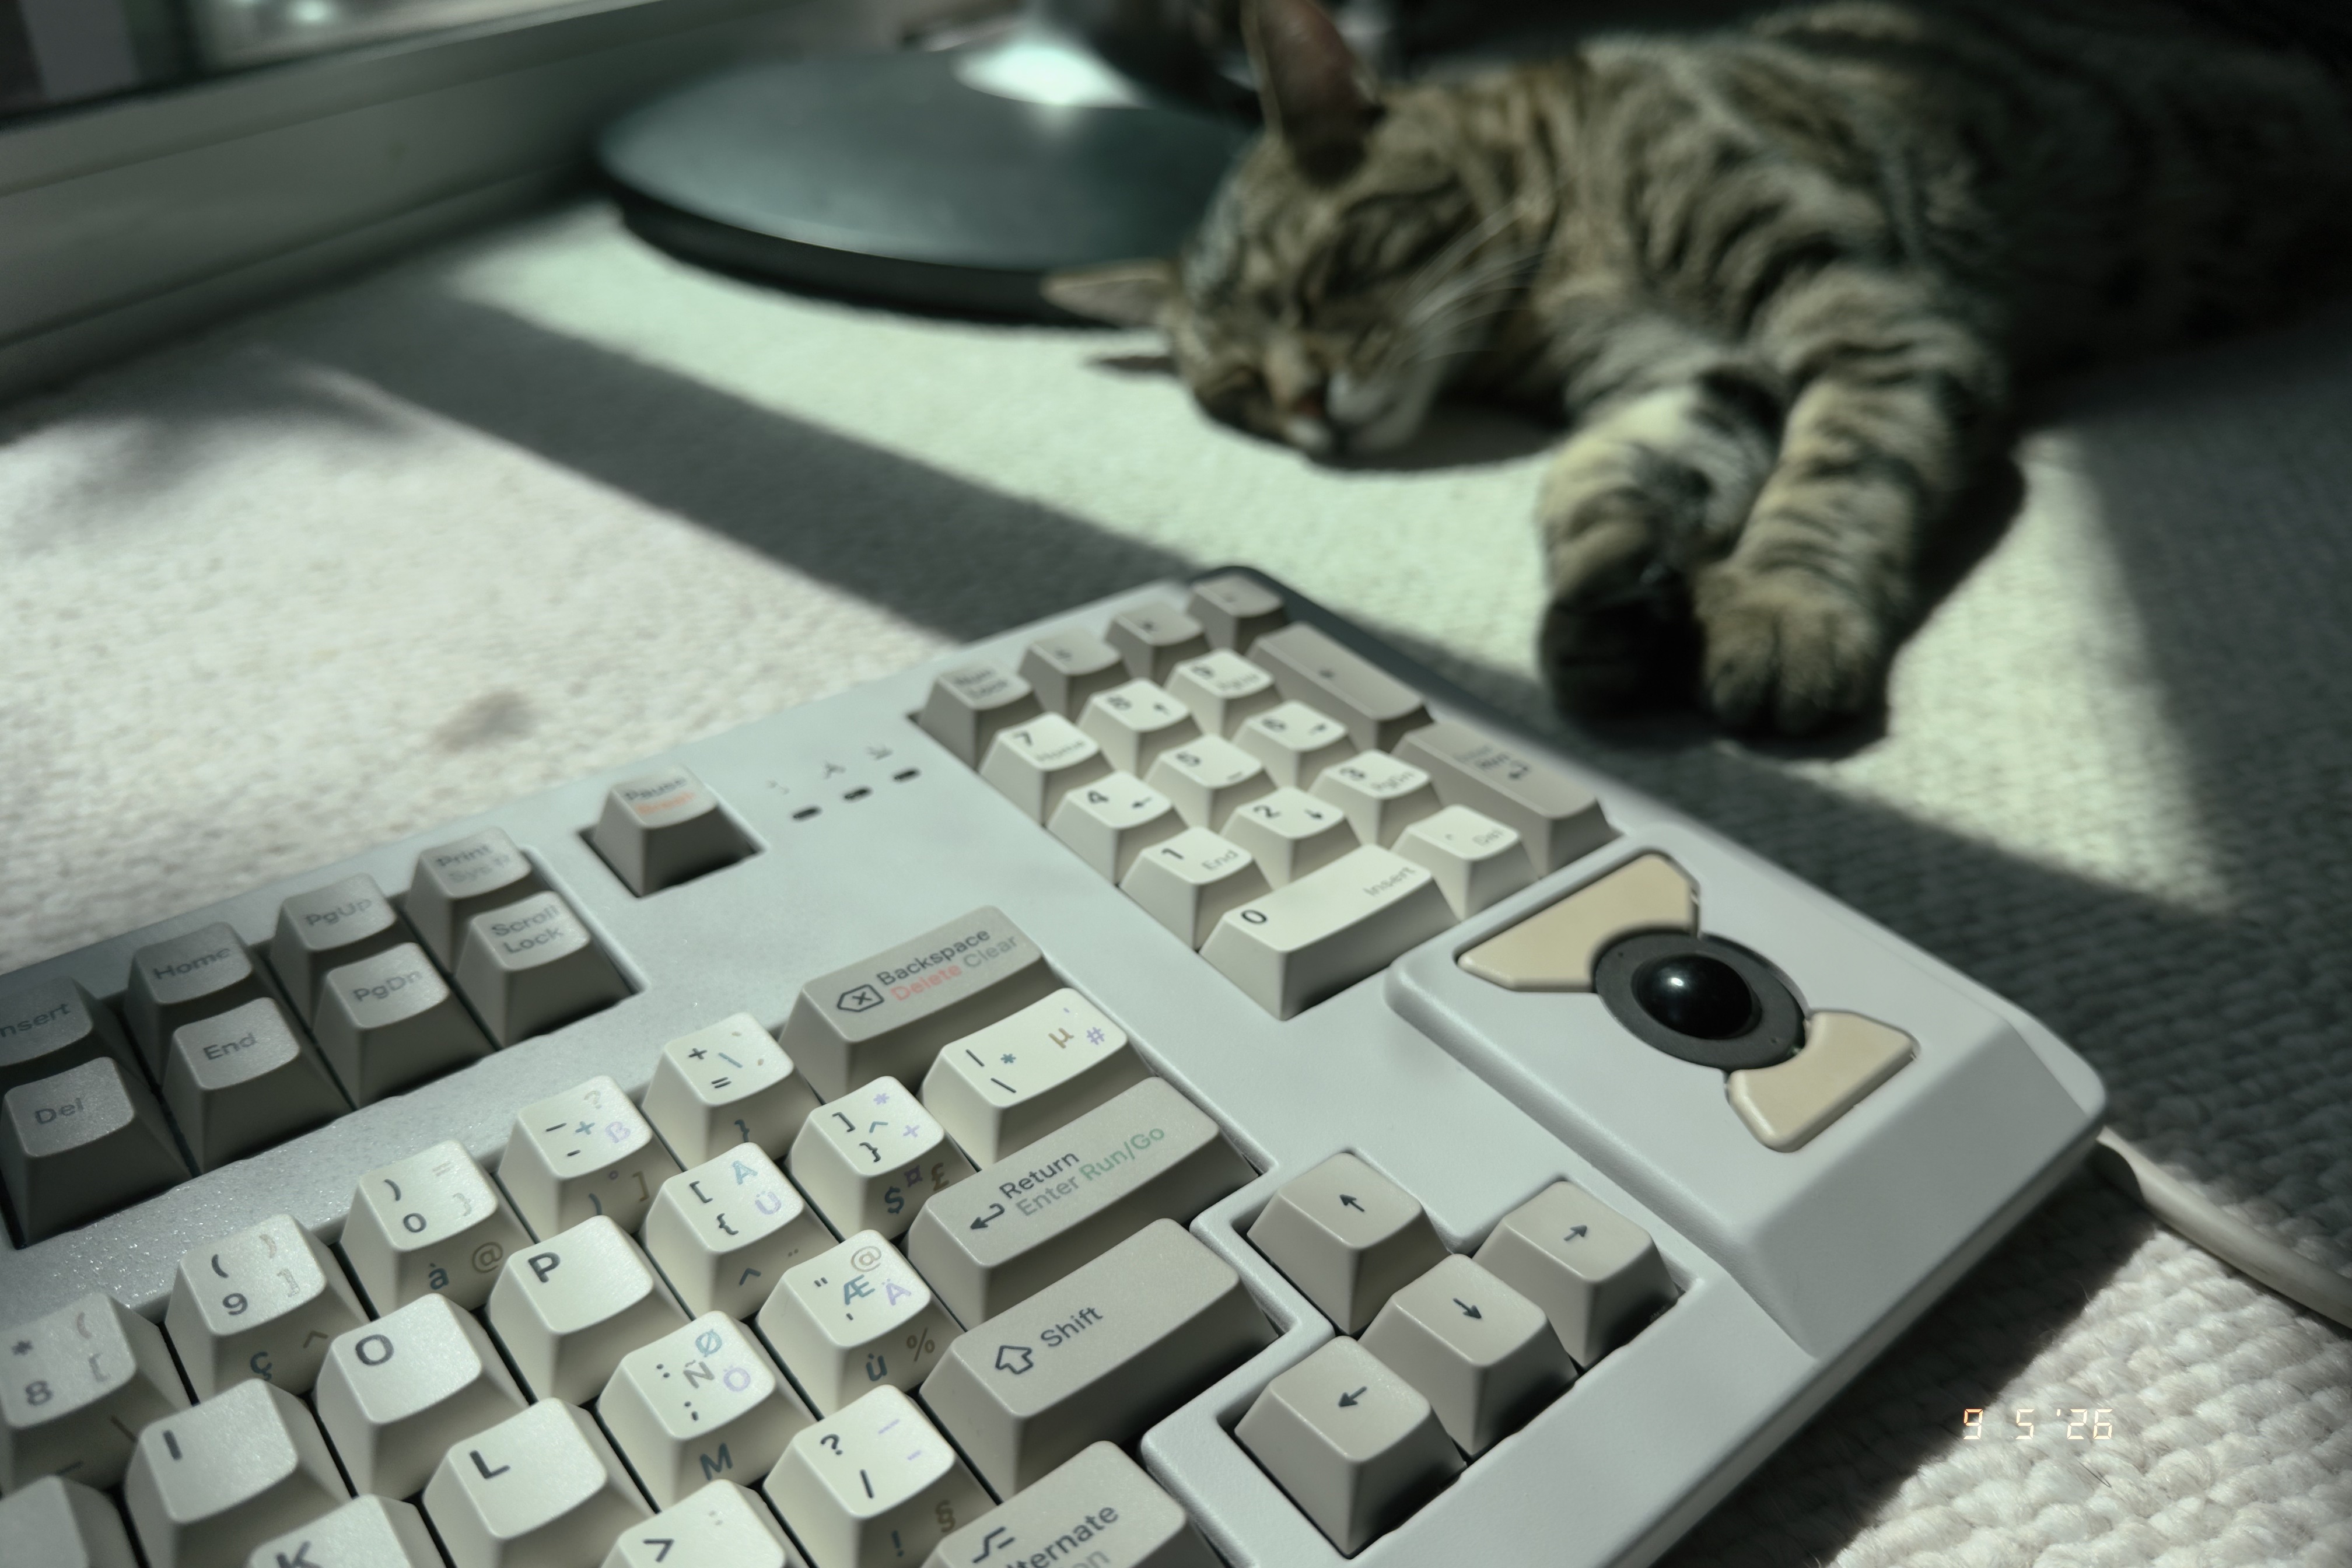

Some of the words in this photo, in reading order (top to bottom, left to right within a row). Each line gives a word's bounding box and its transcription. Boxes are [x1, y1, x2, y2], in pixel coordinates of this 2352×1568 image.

[1087, 790, 1110, 804] 4
[1252, 804, 1282, 820] 2
[1161, 848, 1184, 860] 1
[1201, 849, 1240, 872] End
[1363, 865, 1418, 897] Insert
[304, 898, 373, 926] PgUp
[491, 904, 562, 937] Scroll
[1240, 909, 1268, 926] 0
[502, 926, 565, 954] Lock
[153, 947, 231, 980] Home
[877, 930, 991, 986] Backspace
[890, 964, 963, 1002] Delete
[963, 936, 1018, 968] Clear
[353, 970, 424, 1002] PgDn
[202, 1032, 258, 1061] End
[35, 1097, 85, 1125] Del
[999, 1153, 1080, 1199] Return
[1016, 1176, 1080, 1217] Enter
[1079, 1128, 1165, 1181] Run/Go
[428, 1262, 450, 1290] à
[471, 1241, 505, 1273] @
[528, 1251, 561, 1283] P
[850, 1245, 883, 1272] @
[222, 1292, 249, 1316] 9
[844, 1274, 876, 1306] Æ
[881, 1278, 912, 1306] Ä
[1040, 1306, 1104, 1349] Shift
[355, 1334, 395, 1367] O
[906, 1326, 936, 1363] %
[682, 1359, 716, 1390] Ñ
[24, 1380, 54, 1407] 8
[162, 1429, 183, 1461] I
[820, 1433, 844, 1457] ?
[469, 1449, 511, 1480] L
[701, 1443, 734, 1481] M
[1007, 1506, 1119, 1568] ternate
